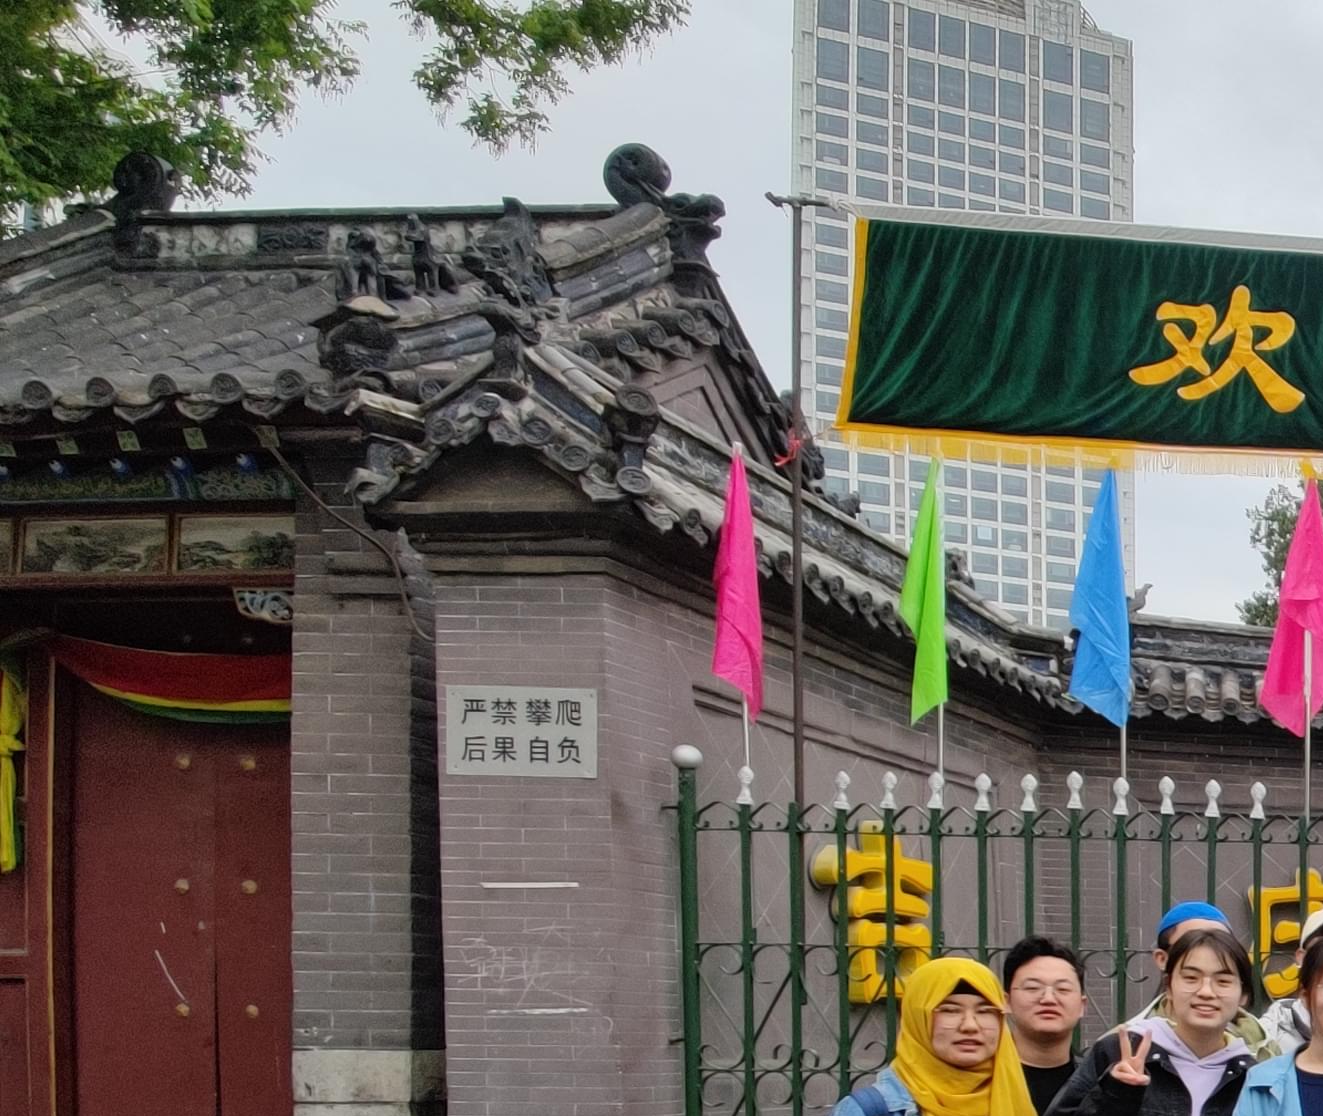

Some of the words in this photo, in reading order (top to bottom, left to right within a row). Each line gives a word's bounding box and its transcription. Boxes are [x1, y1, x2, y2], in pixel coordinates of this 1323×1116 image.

[461, 697, 583, 727] 严禁攀爬
[461, 735, 582, 765] 后果自负
